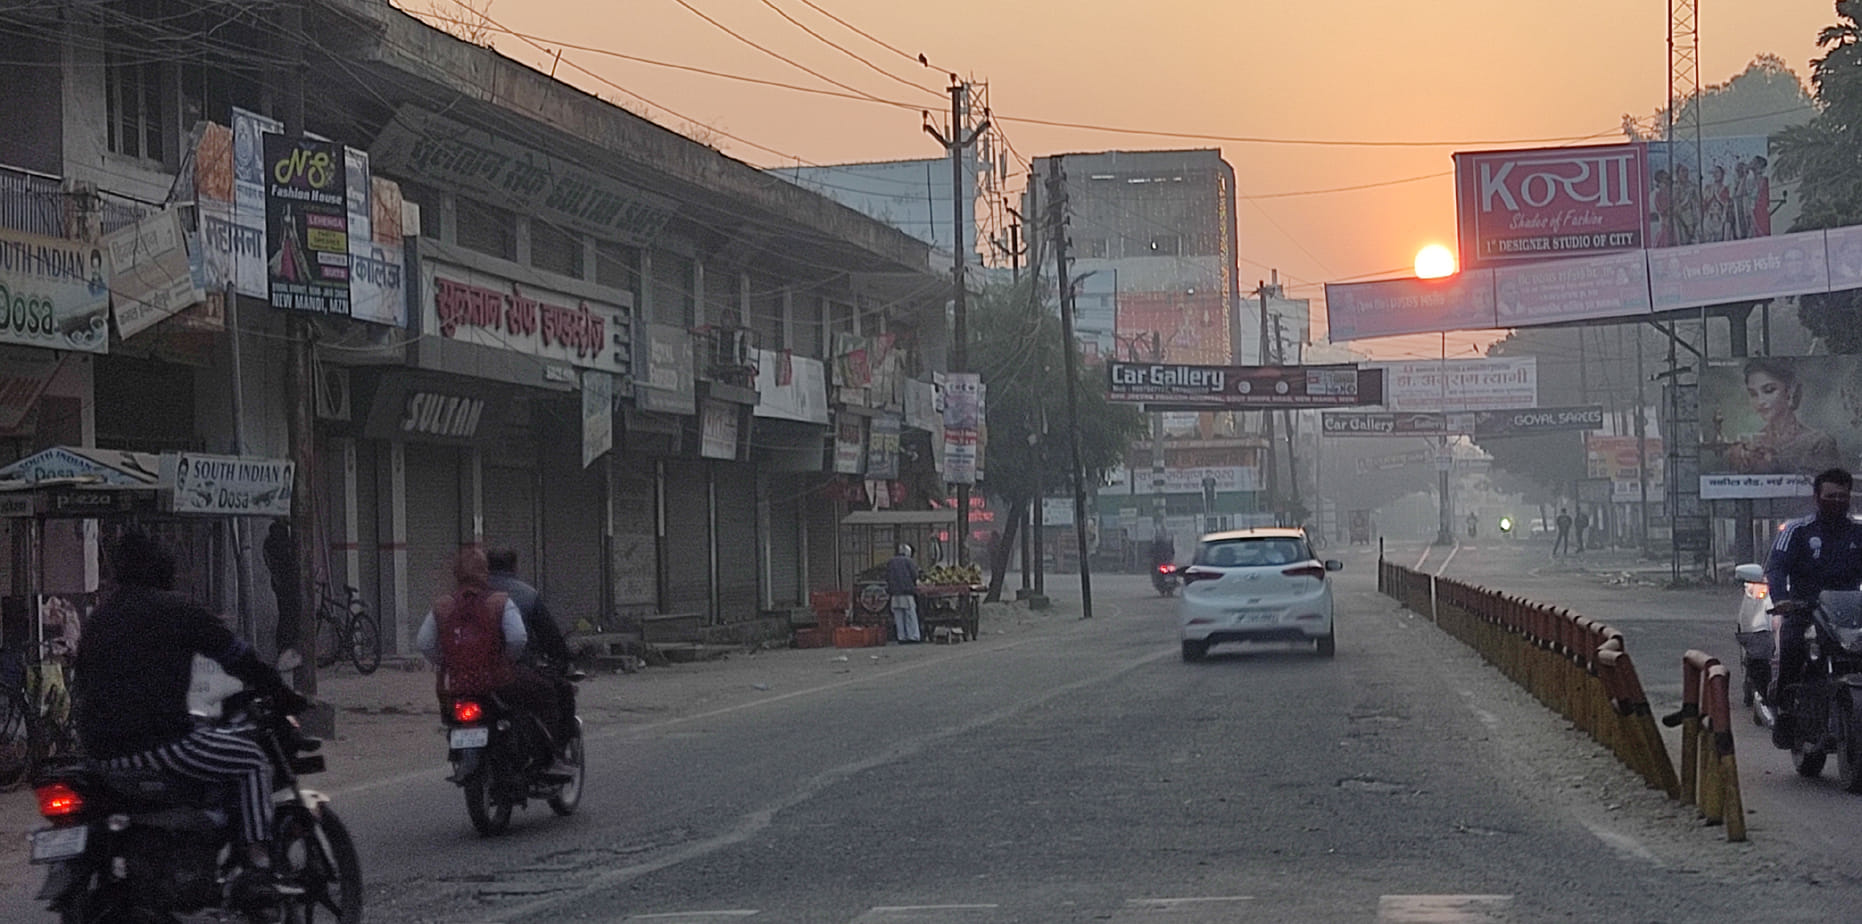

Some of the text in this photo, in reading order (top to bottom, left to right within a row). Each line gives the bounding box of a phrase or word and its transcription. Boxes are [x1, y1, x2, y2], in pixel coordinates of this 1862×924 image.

[272, 184, 310, 201] Fashion
[311, 190, 343, 205] House
[1509, 209, 1604, 233] Shades of Fashion
[1500, 237, 1551, 252] DESIGNER
[1552, 235, 1590, 249] STUDIO
[1593, 234, 1607, 247] OF
[1609, 232, 1634, 246] CITY
[37, 245, 84, 281] INDIAN
[272, 292, 293, 308] NEW
[329, 298, 349, 315] MZN
[1112, 364, 1225, 392] Car Gallery
[404, 392, 485, 437] SULTAN
[1324, 416, 1395, 433] Car Gallery
[1514, 411, 1601, 427] GOYAL SAREES
[19, 450, 93, 472] SOUTH INDIAN
[194, 460, 281, 482] SOUTH INDIAN
[34, 467, 75, 481] Dosa
[218, 488, 249, 508] Dosa
